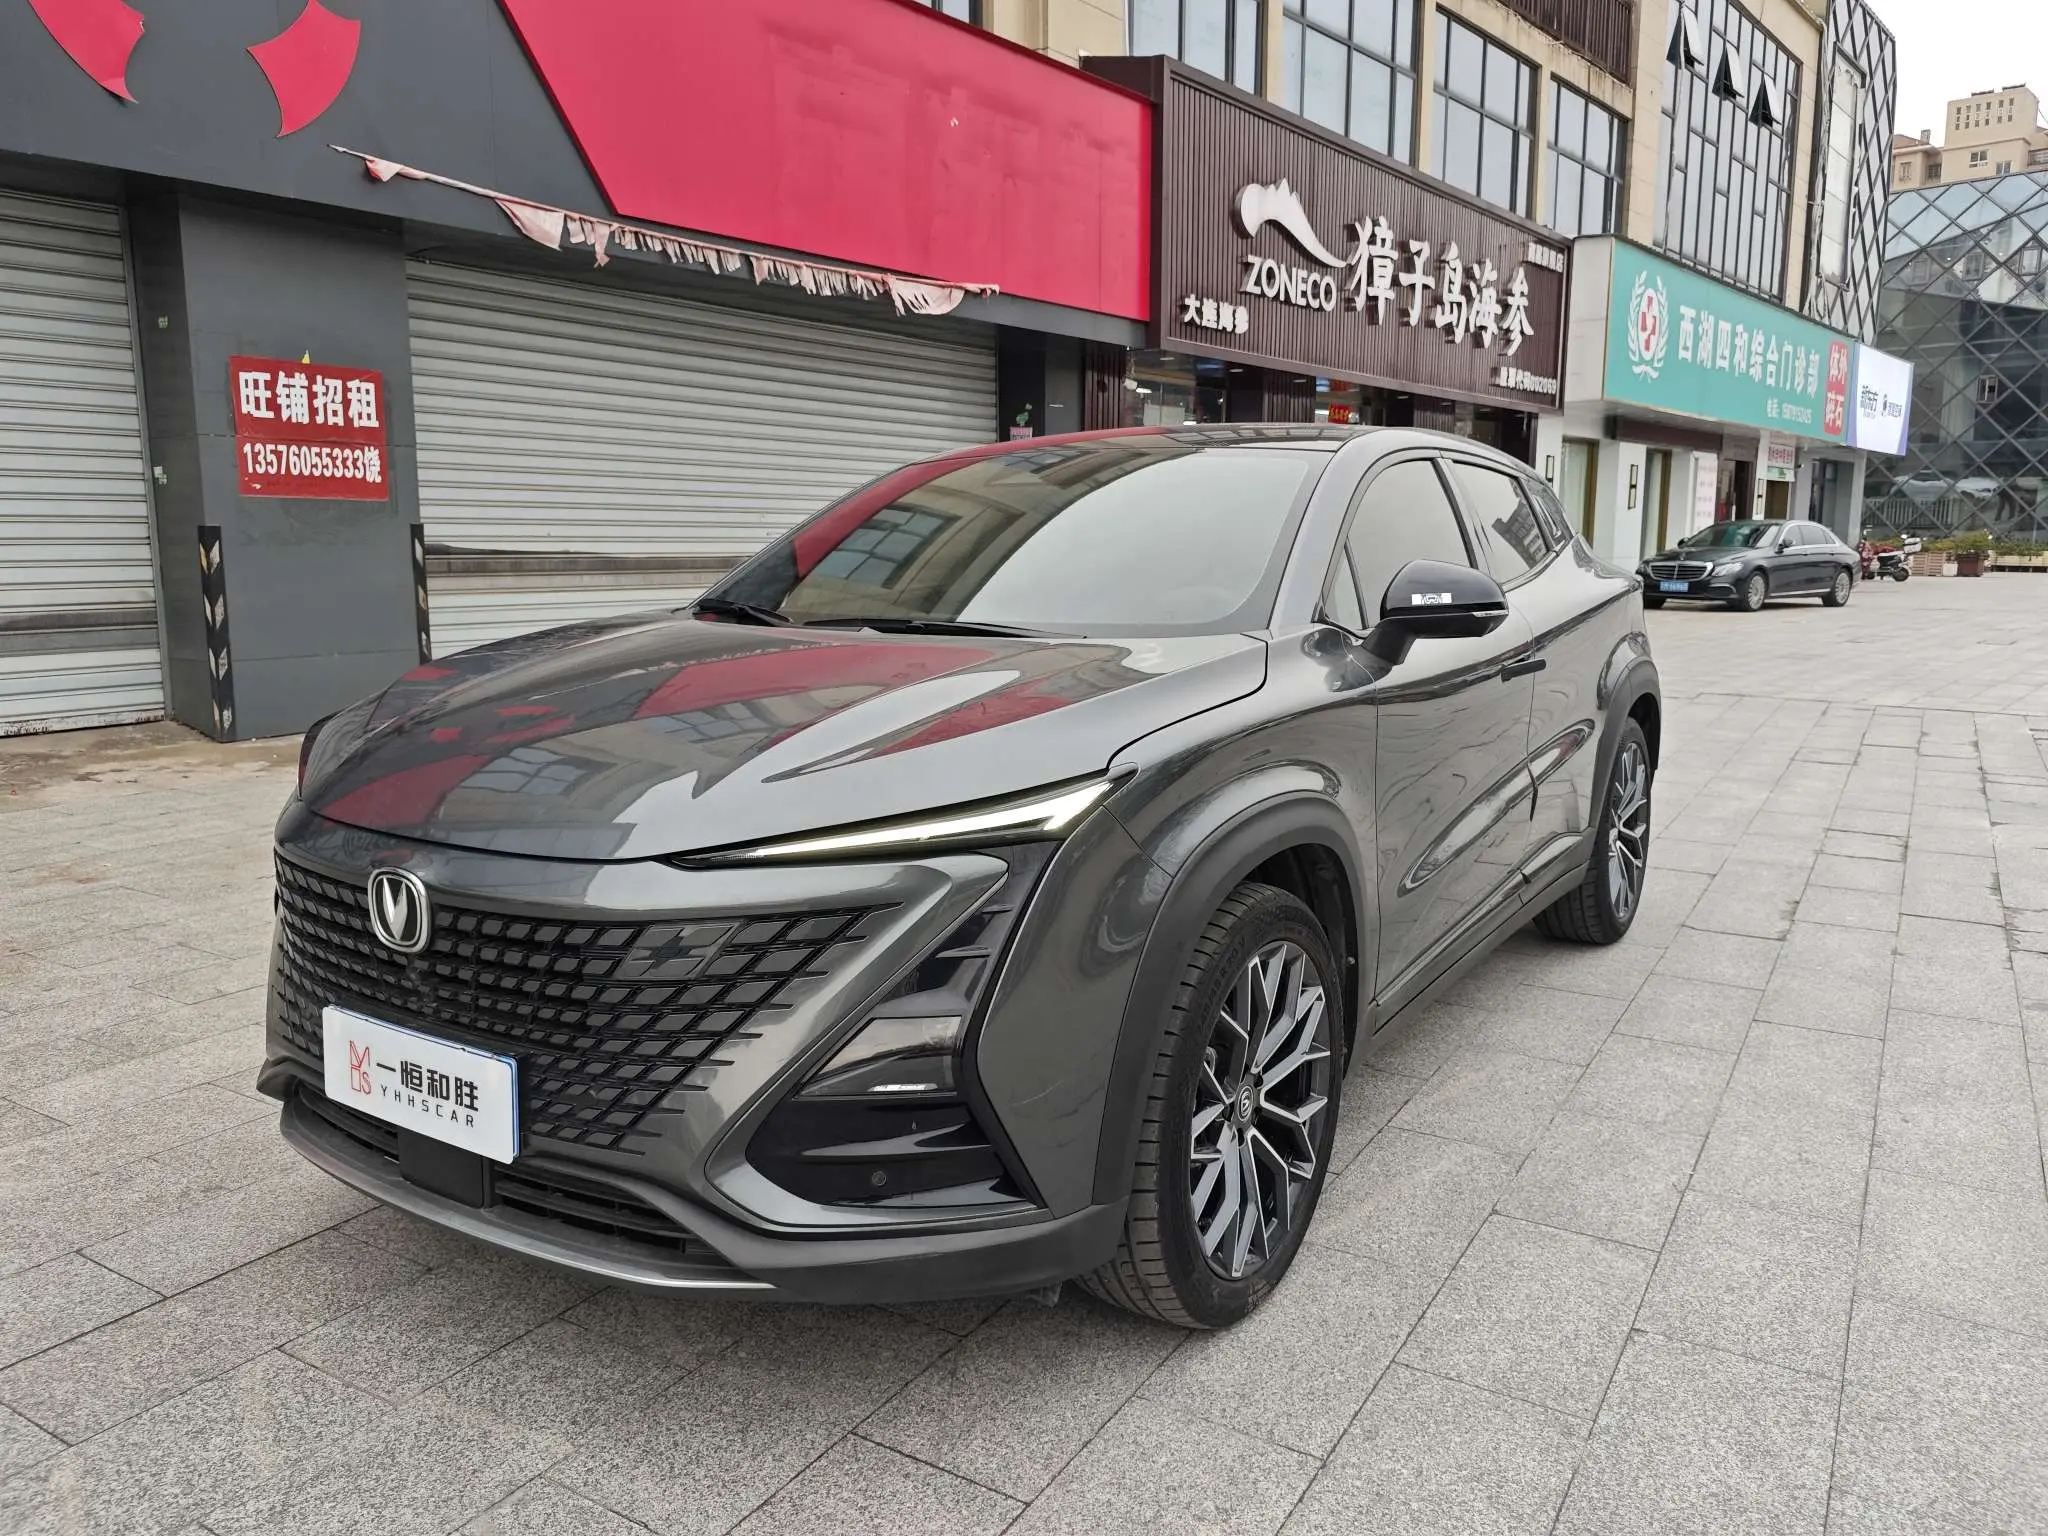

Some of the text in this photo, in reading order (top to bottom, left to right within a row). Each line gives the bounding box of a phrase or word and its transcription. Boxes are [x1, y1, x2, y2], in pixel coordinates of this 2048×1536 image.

[1246, 253, 1337, 312] ZONECO
[1350, 215, 1534, 356] 獐子岛海参
[1678, 305, 1820, 399] 西湖四和综合门诊部
[239, 370, 380, 428] 旺铺招租
[243, 442, 382, 483] 13576055333饶
[376, 1060, 479, 1112] 一恒和胜
[380, 1083, 475, 1128] YHHSCAR
